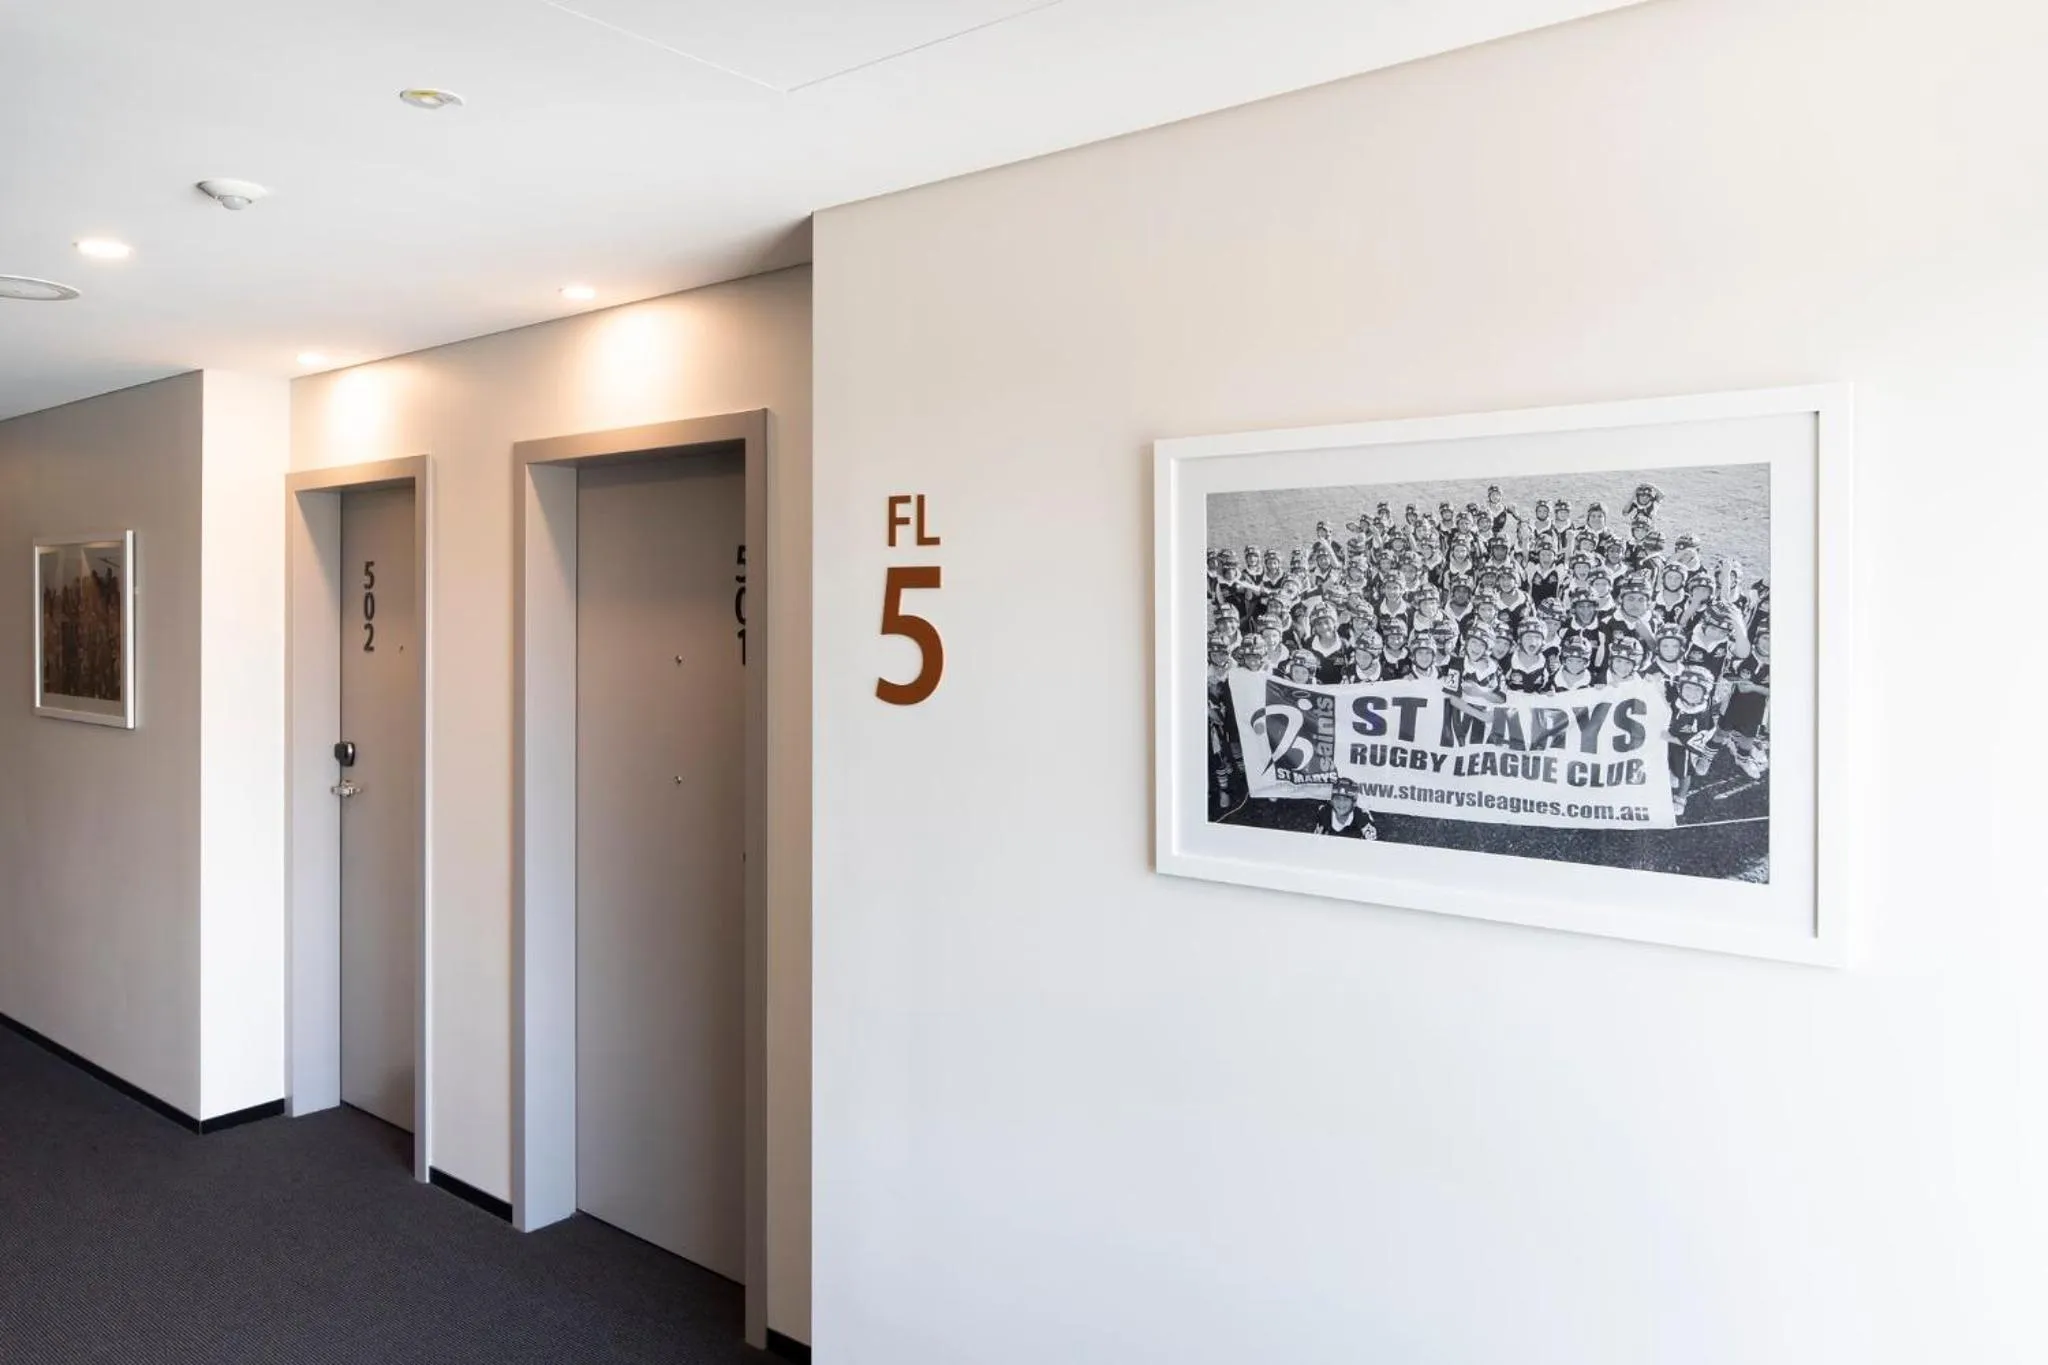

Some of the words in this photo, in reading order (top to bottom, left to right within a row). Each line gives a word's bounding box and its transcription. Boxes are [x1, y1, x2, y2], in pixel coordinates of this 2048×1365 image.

[887, 494, 941, 547] FL
[363, 560, 375, 652] 502
[875, 566, 944, 706] 5
[1352, 695, 1428, 743] ST
[1440, 697, 1648, 754] MARYS
[1276, 767, 1292, 780] ST
[1349, 742, 1448, 773] RUGBY
[1453, 751, 1558, 784] LEAGUE
[1566, 758, 1647, 788] CLUB
[1358, 781, 1650, 822] ww.stmarysleagues.com.au
